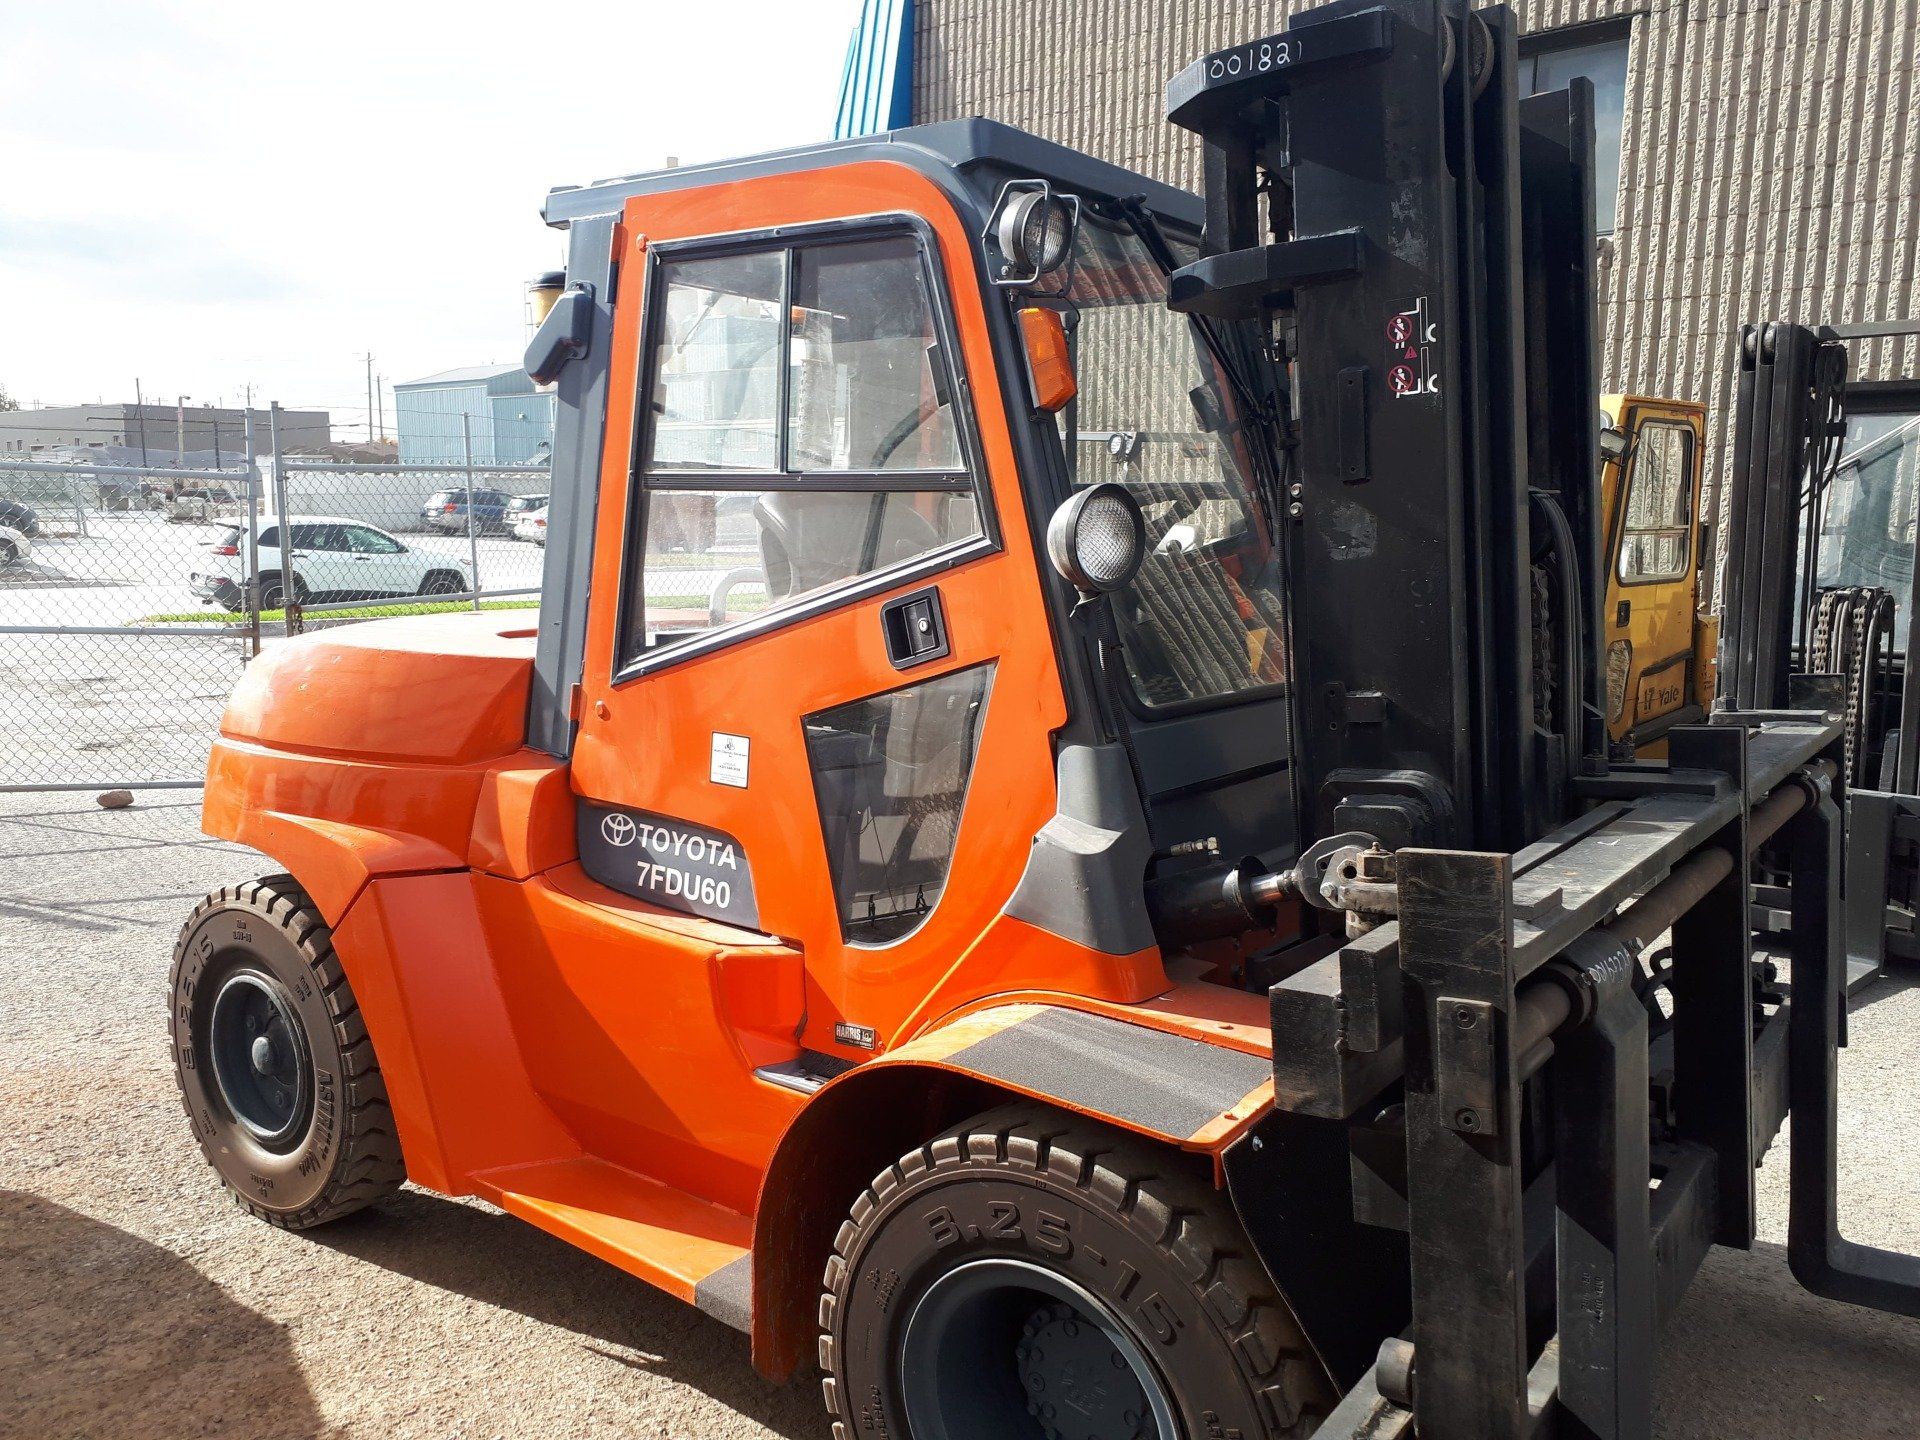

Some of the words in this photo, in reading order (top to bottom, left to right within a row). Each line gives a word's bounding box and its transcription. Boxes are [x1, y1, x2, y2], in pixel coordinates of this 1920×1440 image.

[1658, 686, 1680, 706] Yale
[639, 823, 738, 871] TOYOTA
[637, 861, 731, 909] 7FDU60
[922, 1201, 1186, 1346] 8.25-15
